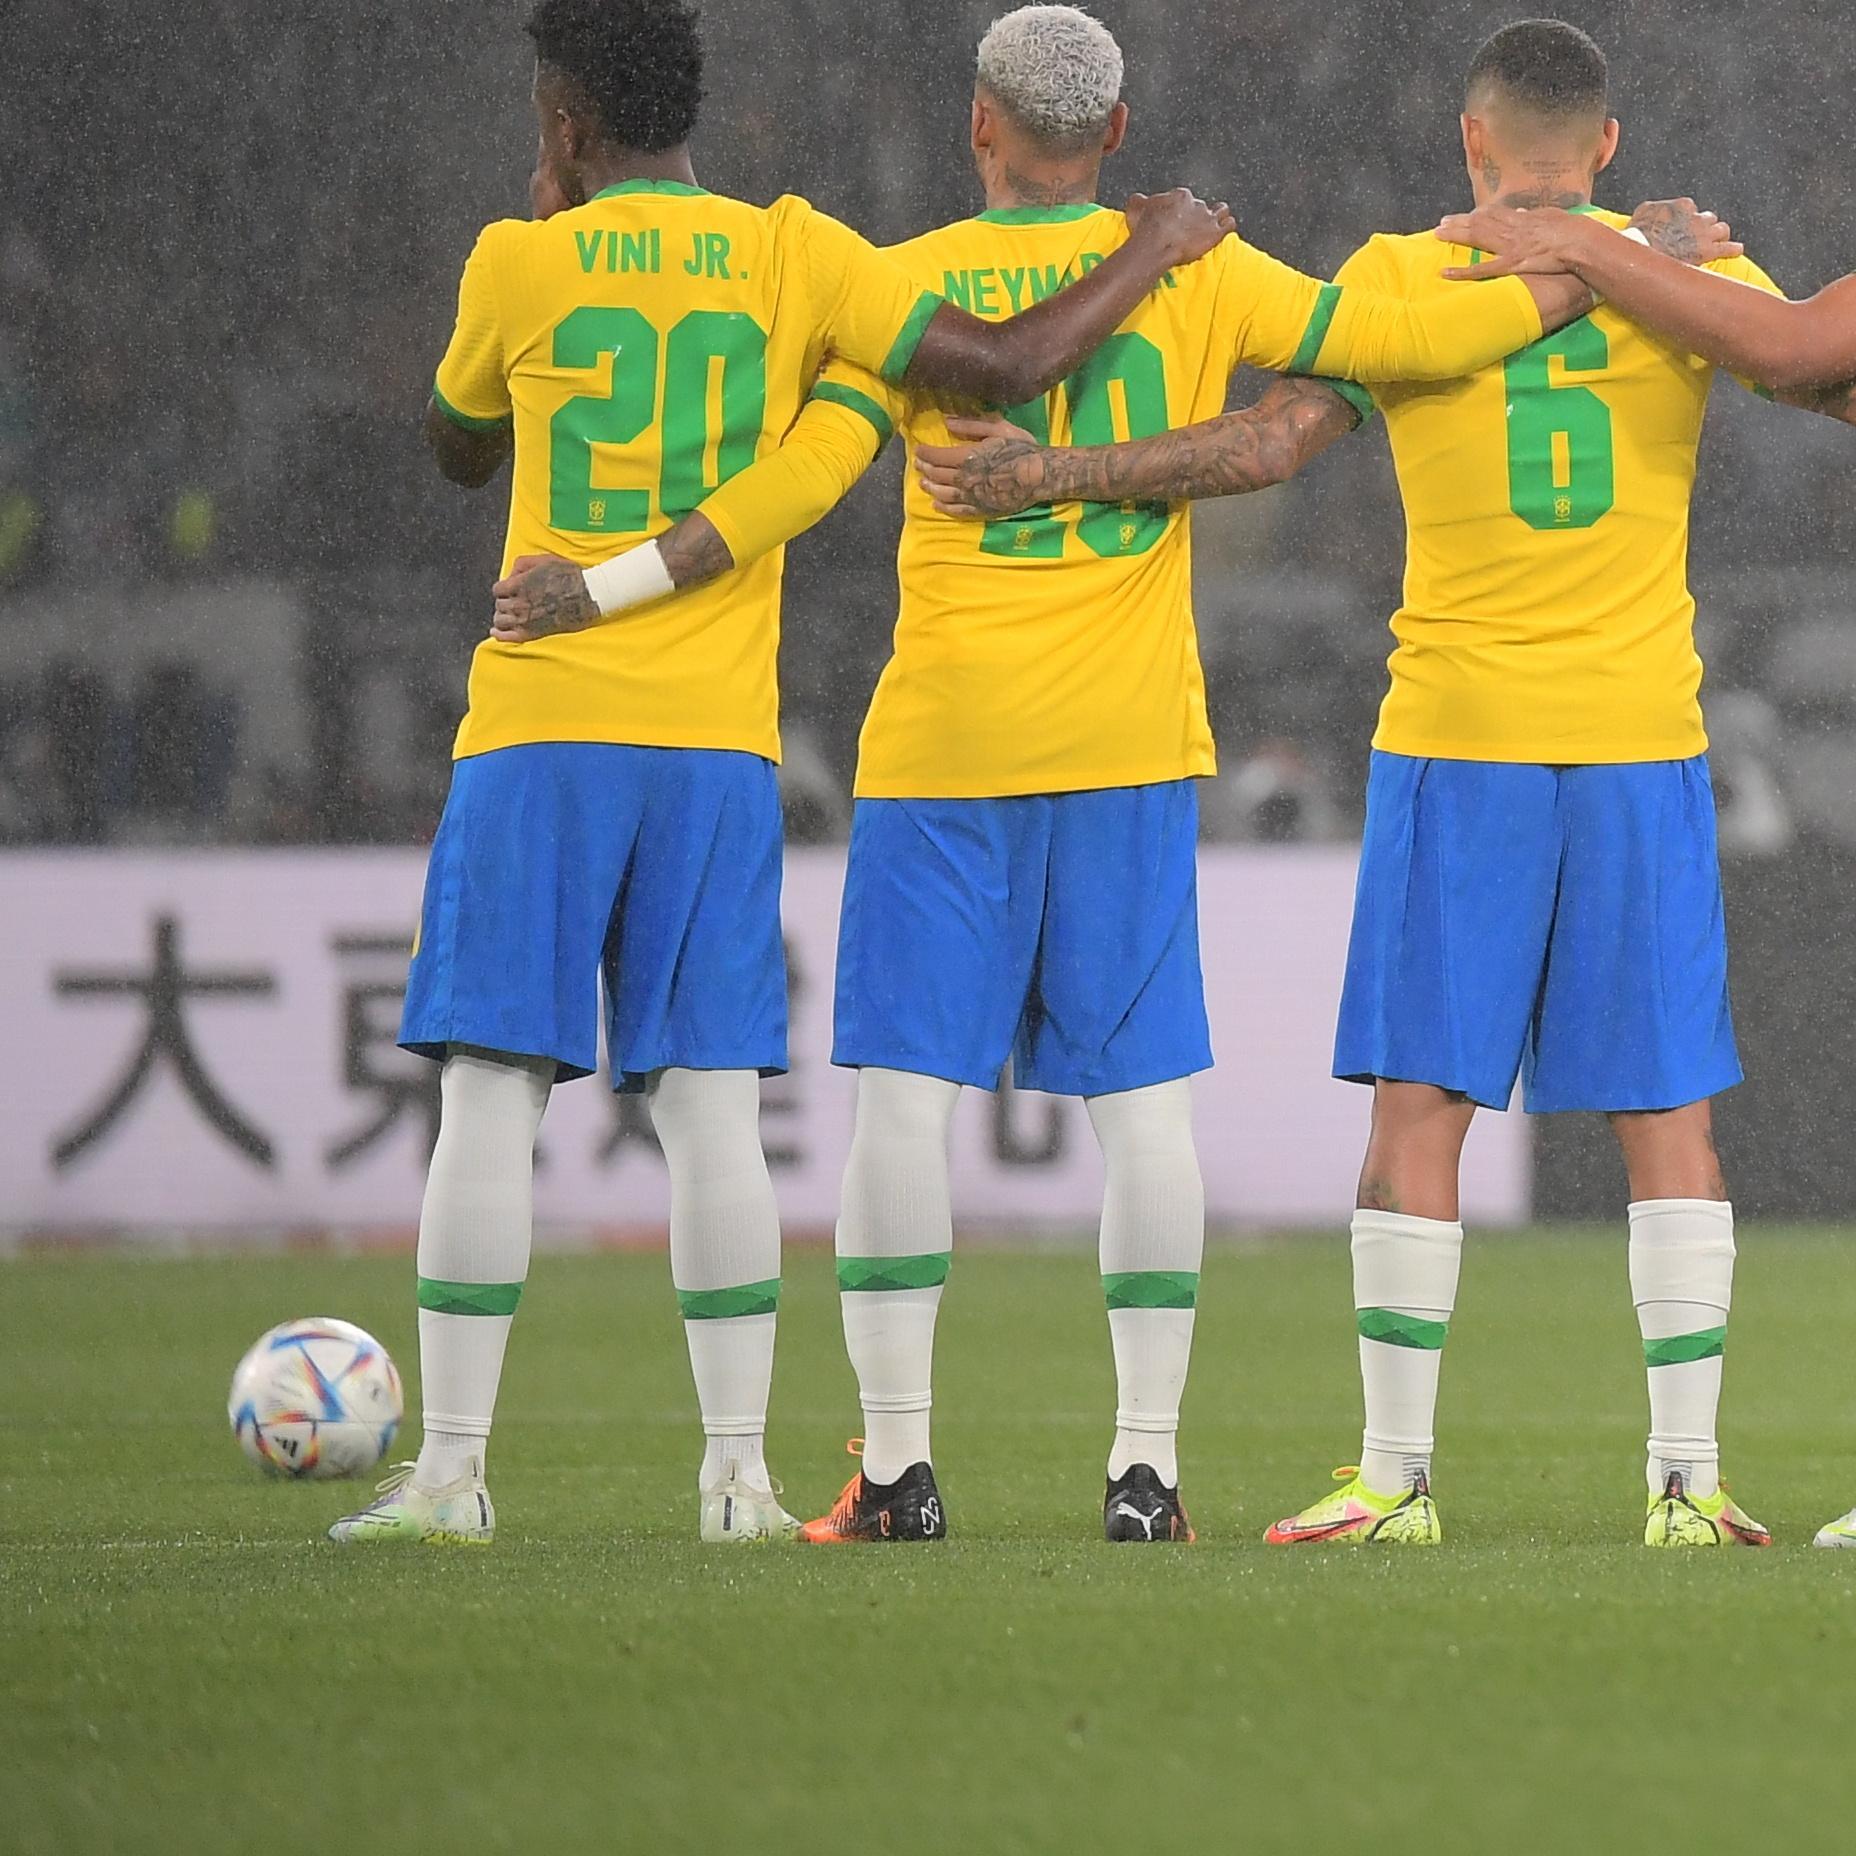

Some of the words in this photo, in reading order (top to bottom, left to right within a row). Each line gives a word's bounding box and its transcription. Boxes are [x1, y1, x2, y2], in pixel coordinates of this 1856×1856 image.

[574, 228, 660, 274] VINI
[683, 232, 748, 280] JR.
[549, 305, 769, 532] 20
[1504, 314, 1615, 531] 6
